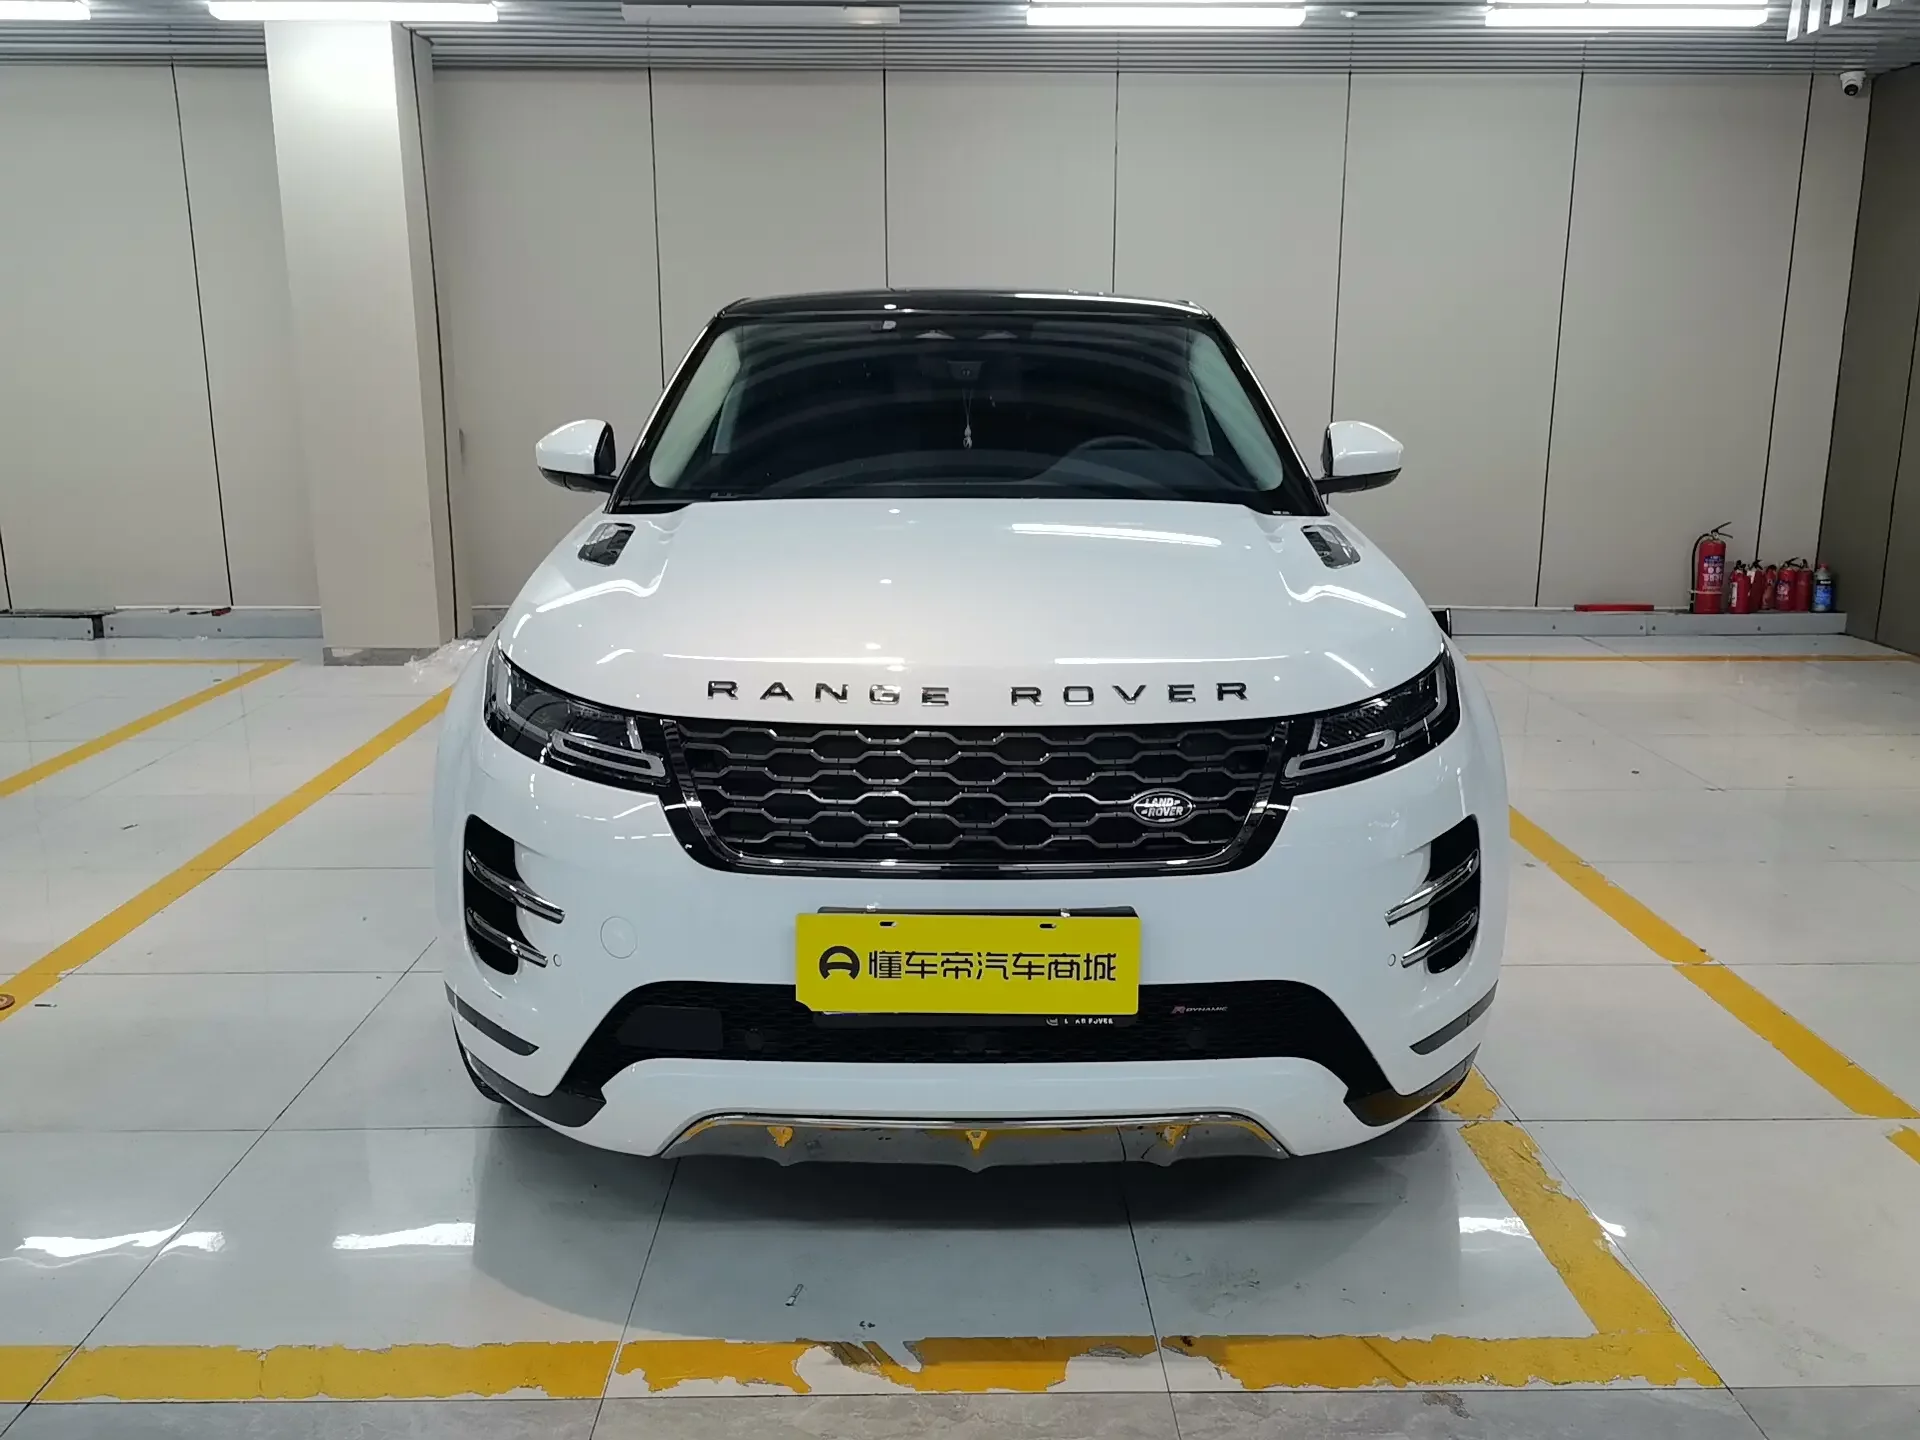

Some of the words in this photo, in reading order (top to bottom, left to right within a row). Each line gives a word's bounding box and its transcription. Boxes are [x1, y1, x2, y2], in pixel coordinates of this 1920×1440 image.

[707, 680, 949, 707] RANGE
[1010, 681, 1247, 707] ROVER
[1144, 797, 1174, 807] LAND
[1147, 806, 1184, 817] ROVER
[868, 950, 1117, 982] 懂车帝汽车商城
